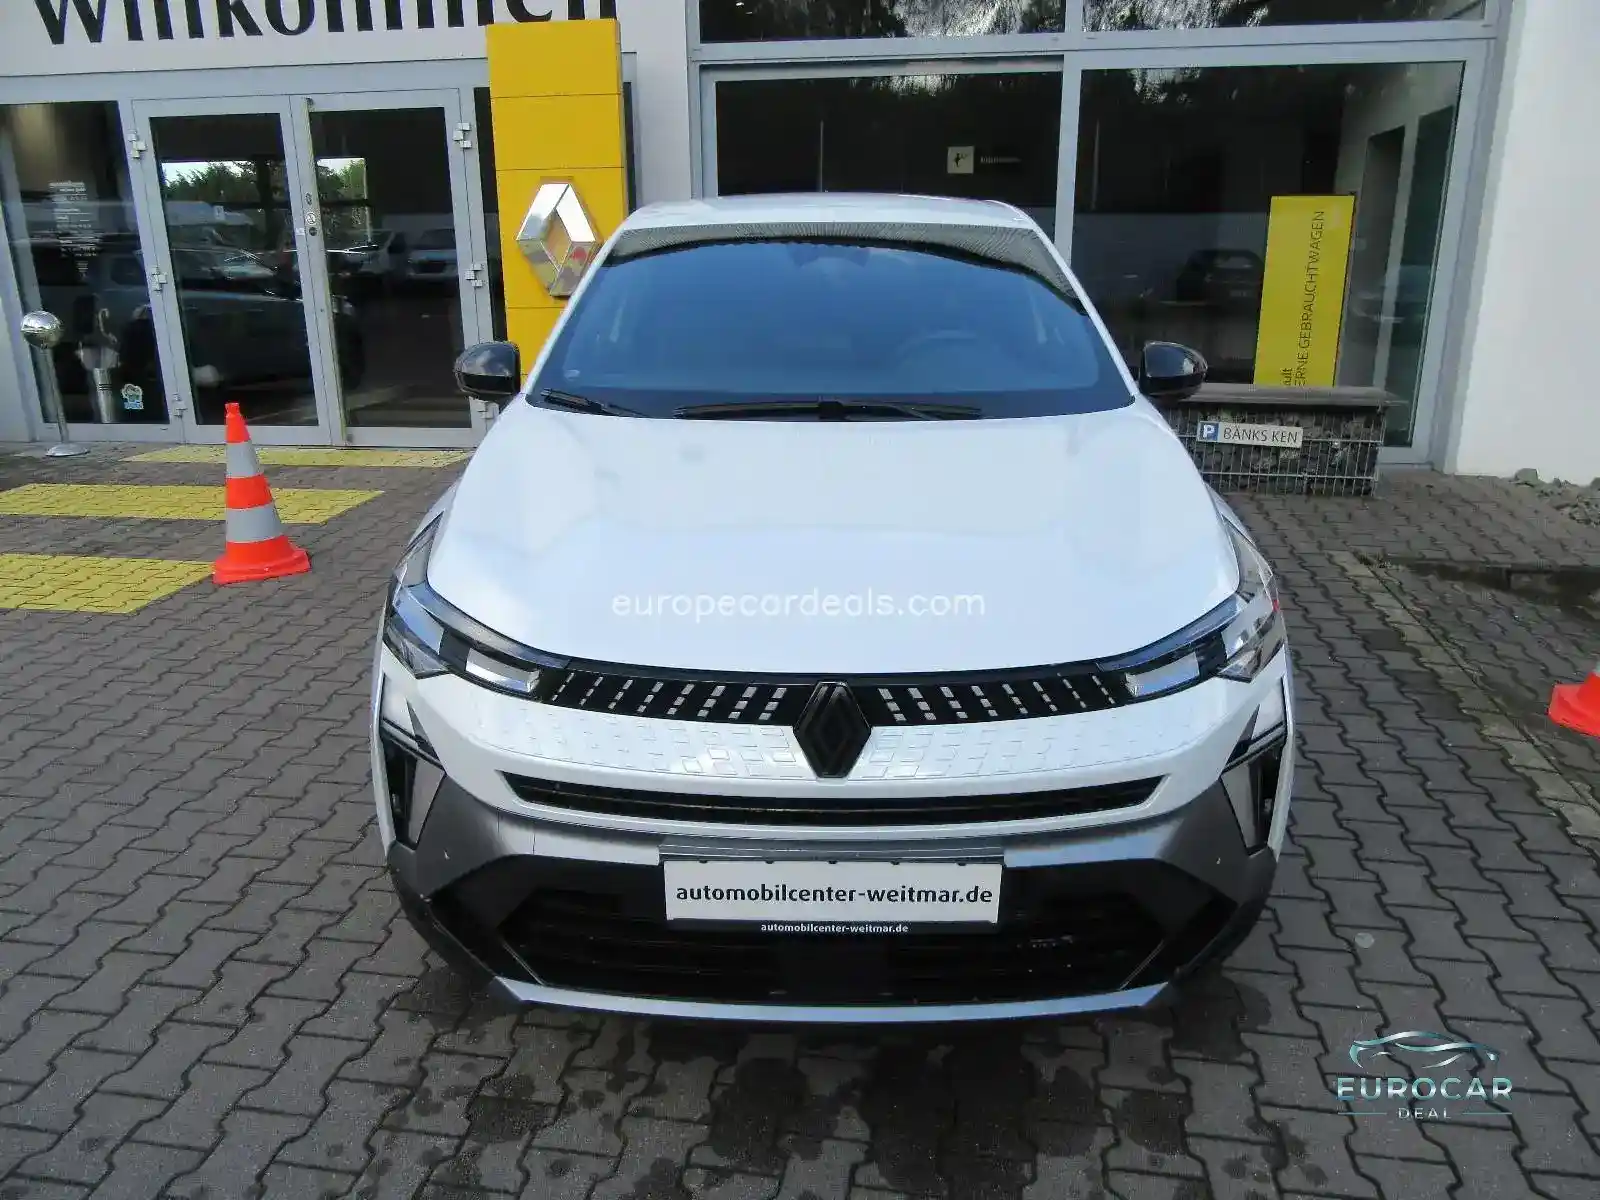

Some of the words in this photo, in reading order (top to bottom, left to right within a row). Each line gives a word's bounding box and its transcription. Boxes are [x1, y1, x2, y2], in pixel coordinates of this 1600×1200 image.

[1298, 210, 1325, 349] GEBRAUCHTWAGEN
[676, 884, 994, 904] automobilcenter-weitmar.de
[760, 922, 910, 934] automobilcenter-weitmar.de
